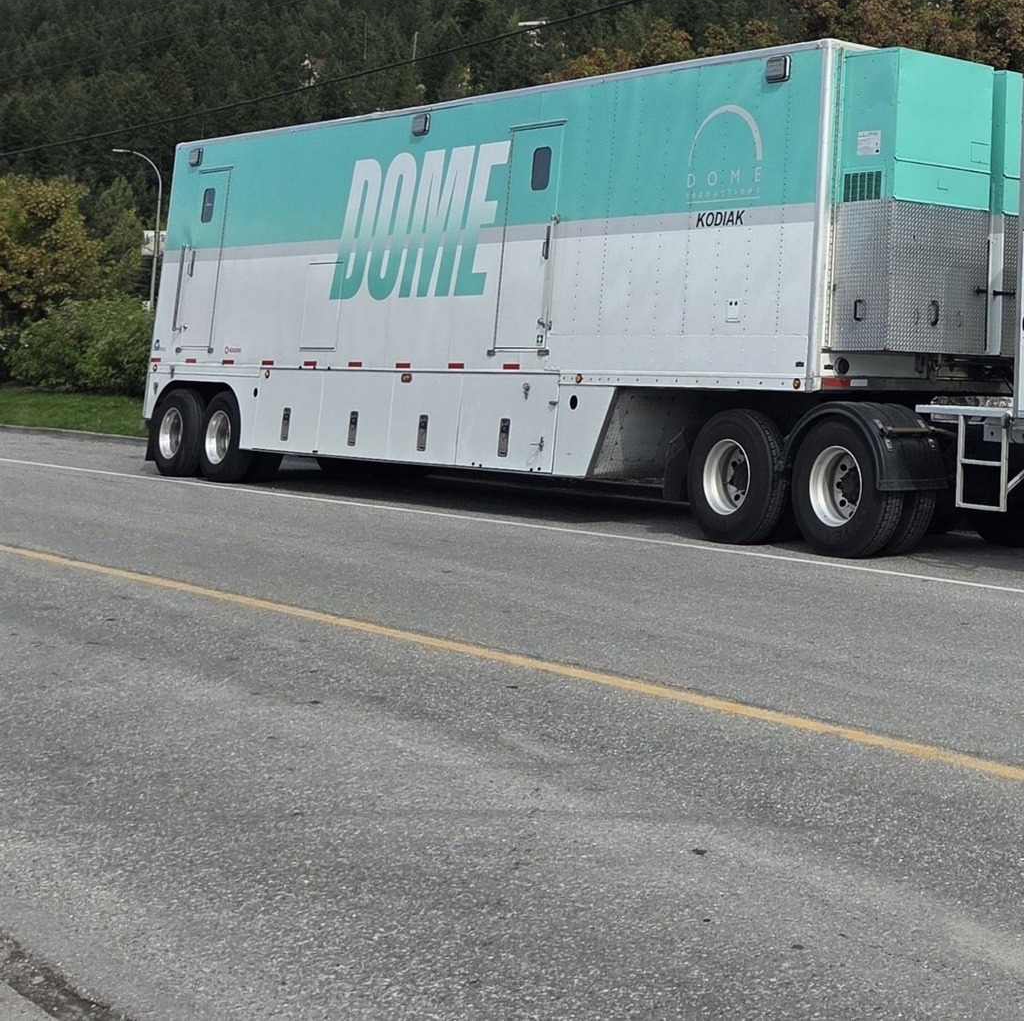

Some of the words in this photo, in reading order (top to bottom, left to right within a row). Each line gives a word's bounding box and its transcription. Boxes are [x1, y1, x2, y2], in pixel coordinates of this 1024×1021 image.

[687, 166, 762, 189] DOME
[329, 140, 511, 301] DOME
[696, 210, 745, 228] KODIAK
